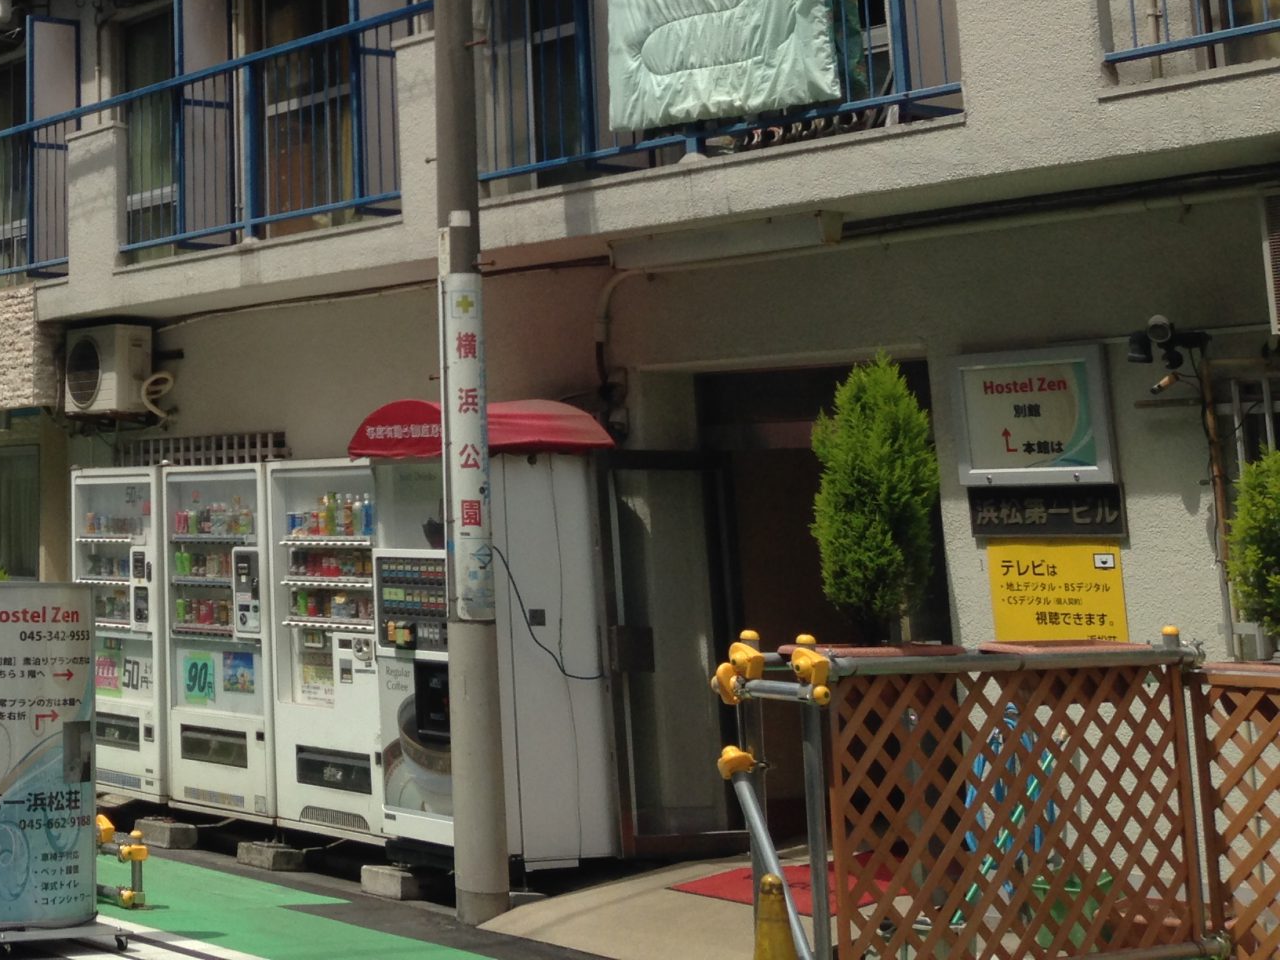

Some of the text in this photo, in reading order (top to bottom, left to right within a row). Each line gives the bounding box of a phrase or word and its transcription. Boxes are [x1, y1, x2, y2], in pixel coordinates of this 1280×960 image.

[983, 376, 1067, 395] Hostel Zen
[1013, 404, 1041, 418] 別館
[456, 331, 482, 528] 横浜公園
[1022, 440, 1064, 455] 本館は
[976, 498, 1119, 526] 浜松第一ビル
[1001, 560, 1057, 576] テレビは
[51, 606, 80, 623] Zen
[1035, 611, 1115, 626] 視聴できます。
[19, 630, 90, 641] 045-342-9553
[385, 666, 410, 678] Regular
[386, 681, 409, 692] Coffee
